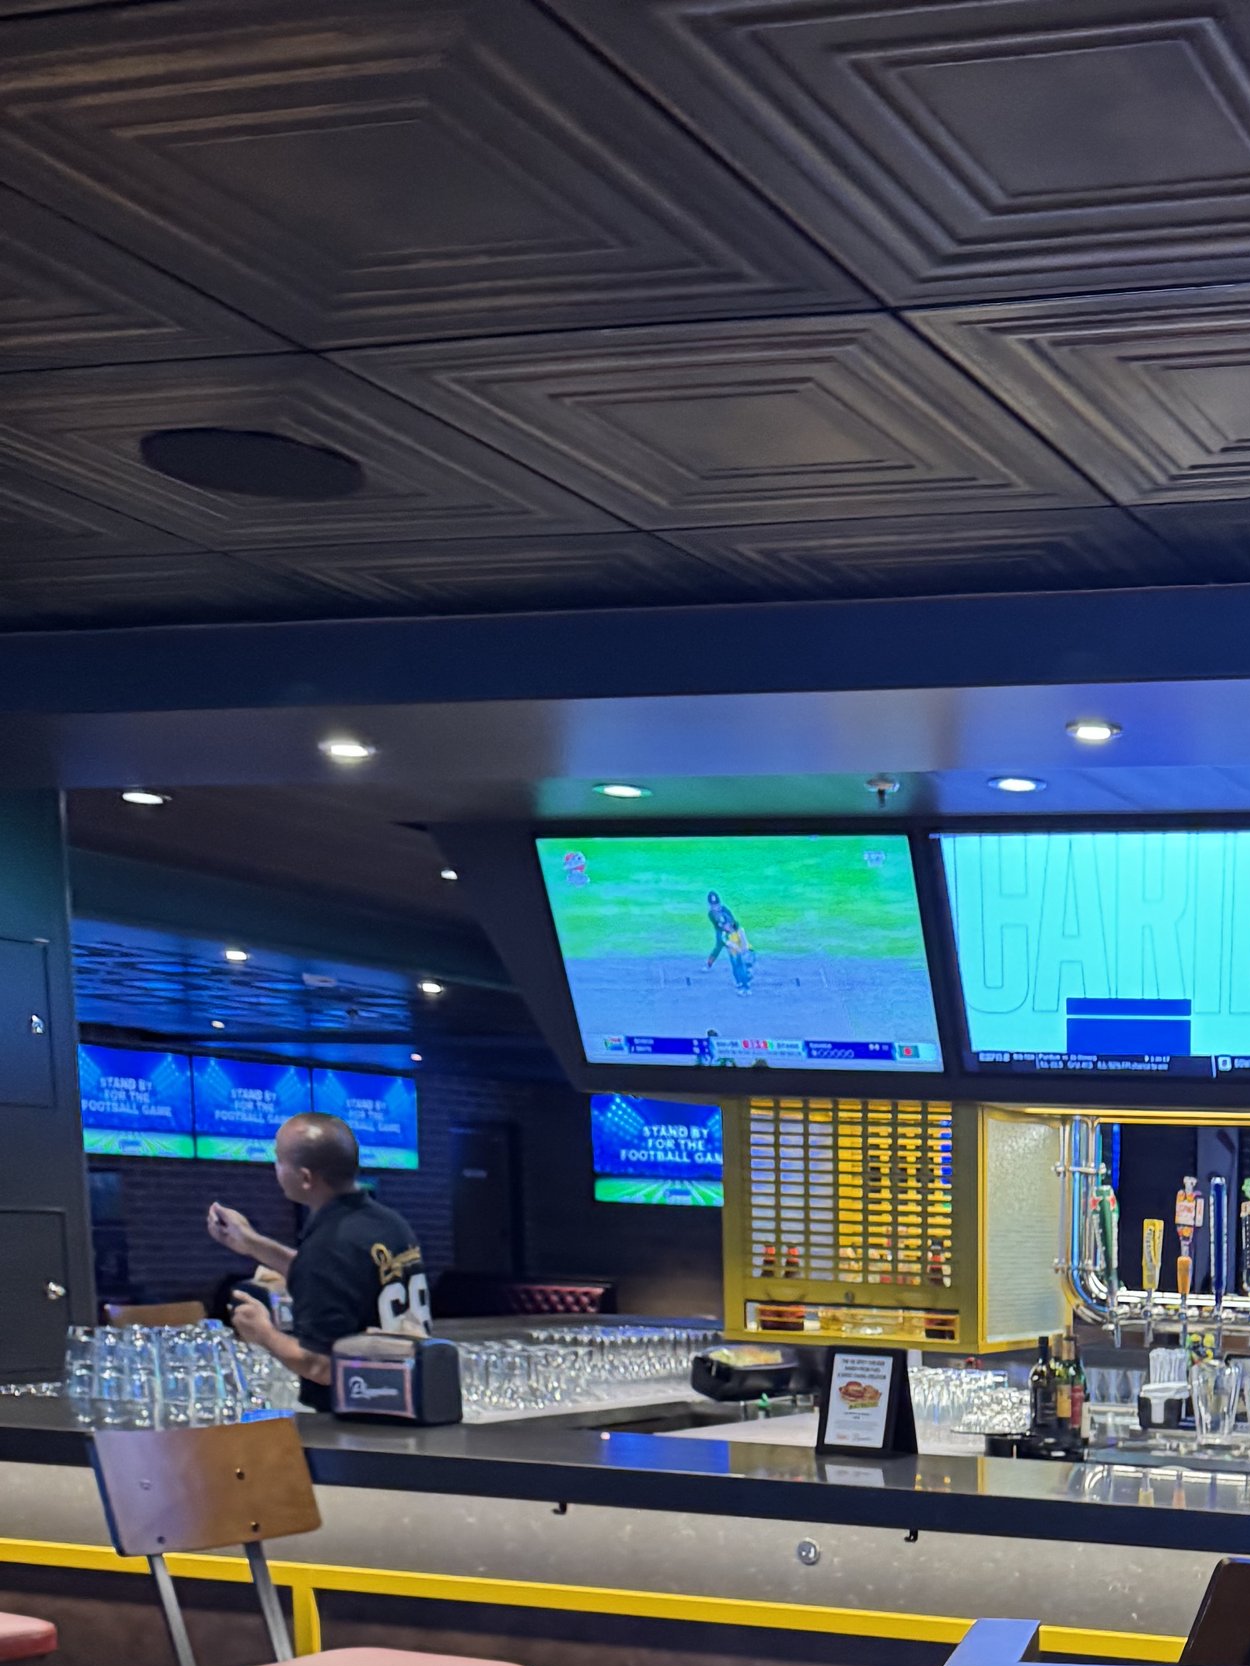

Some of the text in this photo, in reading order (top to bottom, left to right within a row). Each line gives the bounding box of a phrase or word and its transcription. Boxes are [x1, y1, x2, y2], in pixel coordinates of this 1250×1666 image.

[100, 1076, 152, 1091] STAND BY
[104, 1089, 150, 1103] FOR THE
[81, 1099, 172, 1117] FOOTBALL GAME
[643, 1124, 709, 1139] STAND BY
[647, 1138, 704, 1152] FOR THE
[621, 1148, 690, 1162] FOOTBALL
